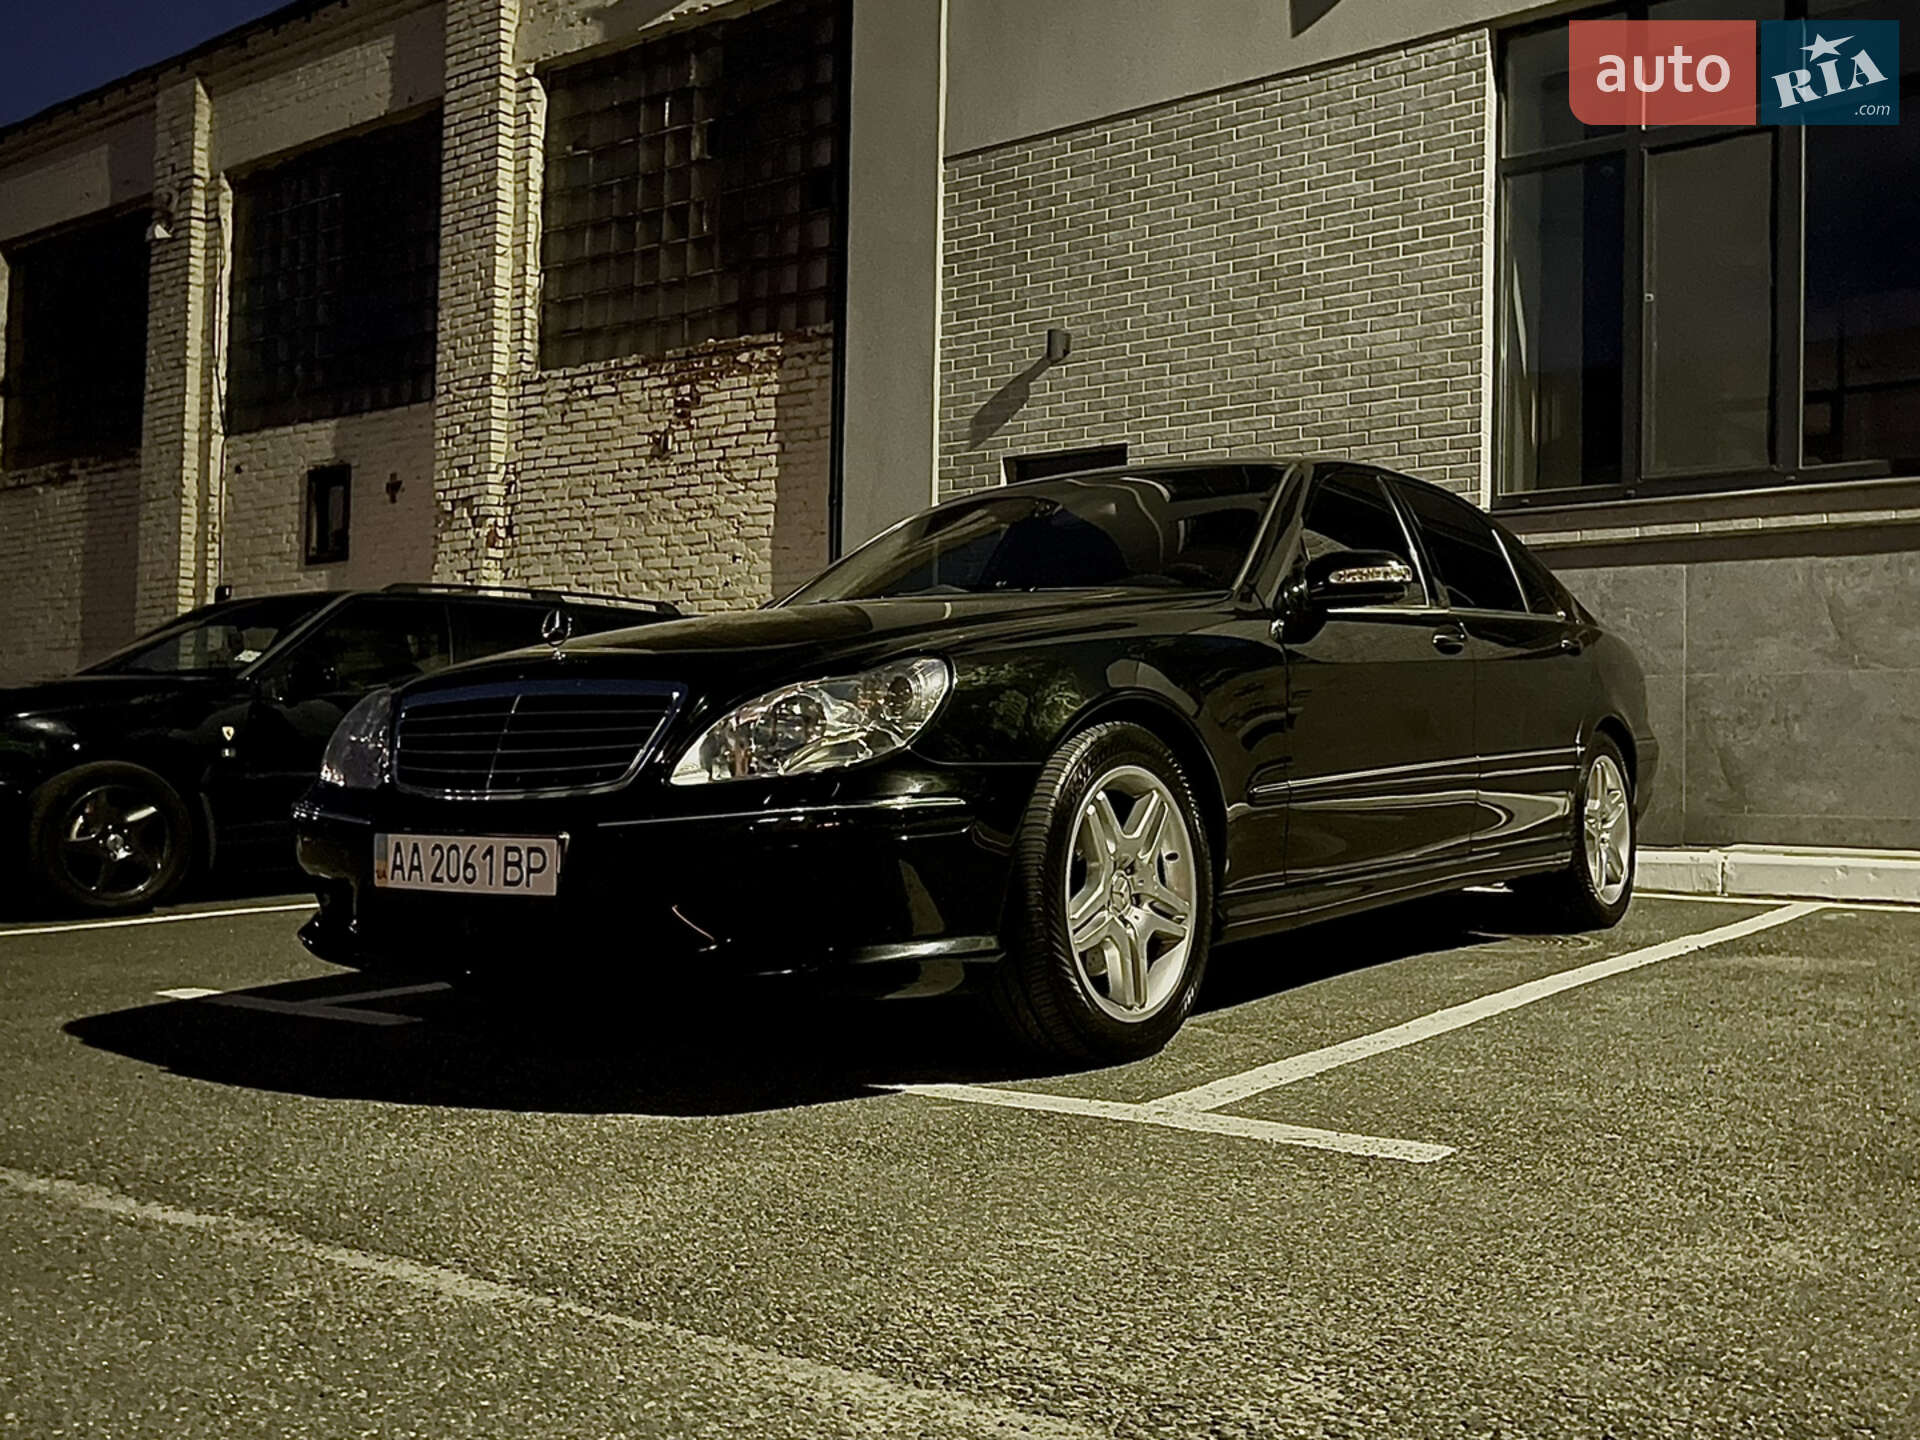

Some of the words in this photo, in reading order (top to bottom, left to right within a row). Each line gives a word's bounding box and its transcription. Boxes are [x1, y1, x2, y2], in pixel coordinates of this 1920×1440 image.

[390, 841, 424, 882] AA
[430, 843, 495, 886] 2061
[503, 845, 547, 888] BP
